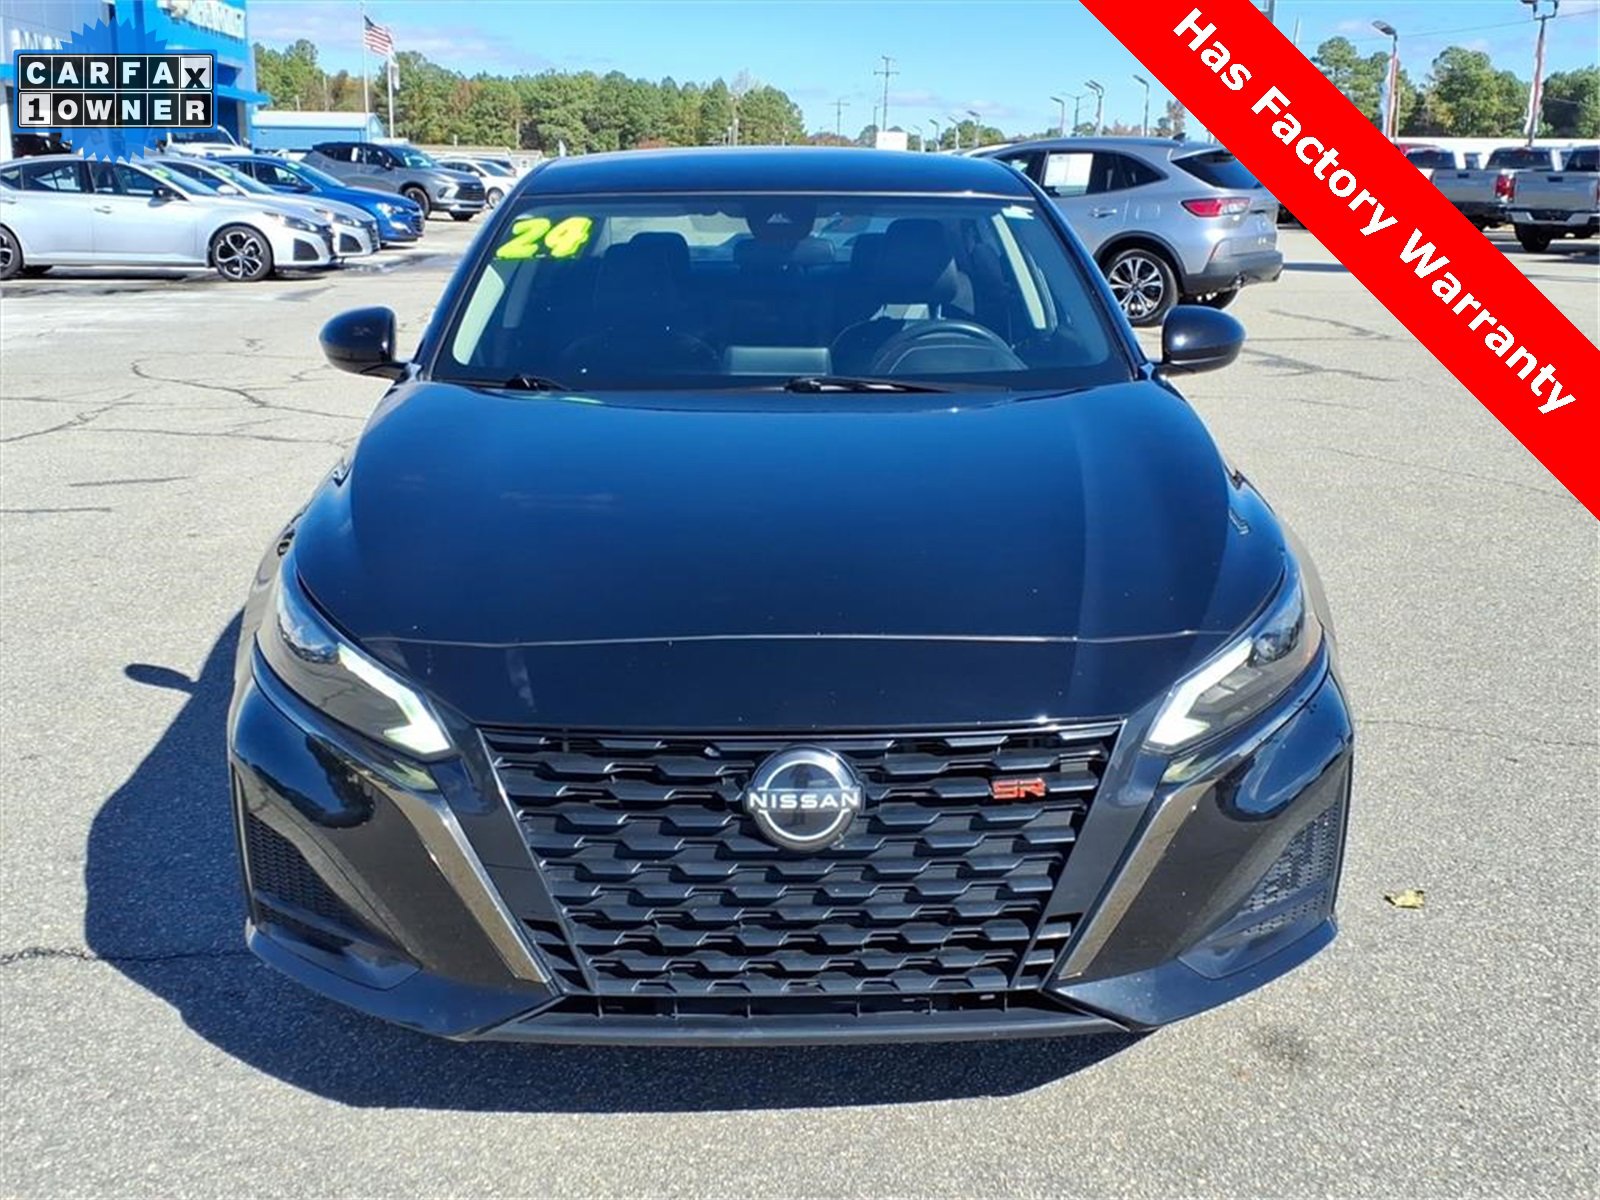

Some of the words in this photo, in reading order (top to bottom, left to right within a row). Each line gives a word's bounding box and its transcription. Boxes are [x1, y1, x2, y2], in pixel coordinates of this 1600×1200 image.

[496, 216, 592, 259] 24
[991, 777, 1046, 799] SR
[749, 791, 859, 809] NISSAN
